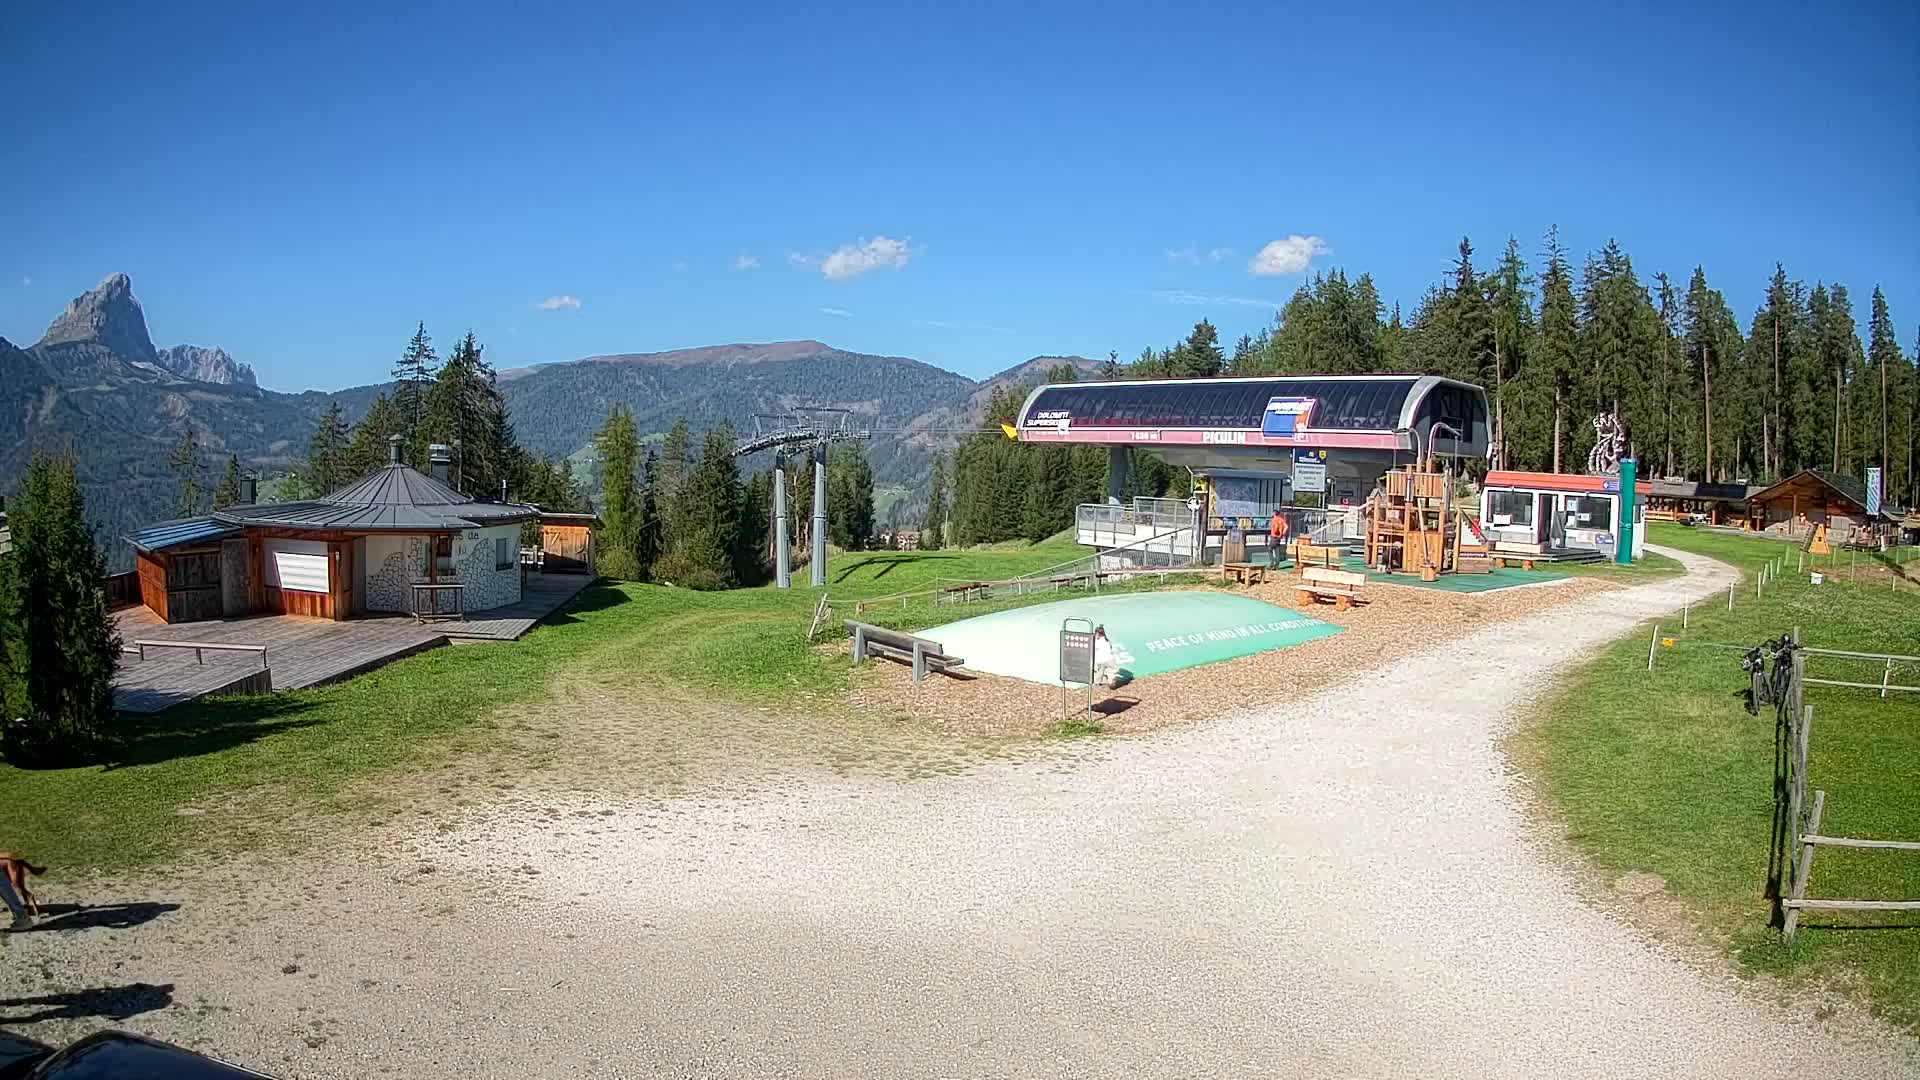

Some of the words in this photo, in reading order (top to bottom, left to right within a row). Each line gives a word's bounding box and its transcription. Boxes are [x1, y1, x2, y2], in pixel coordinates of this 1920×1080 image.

[1202, 432, 1247, 444] PICULIN
[1145, 636, 1190, 653] PEACE
[1187, 633, 1205, 645] OF
[1206, 629, 1236, 641] MIND
[1234, 627, 1250, 638] IN
[1248, 624, 1270, 635] ALL
